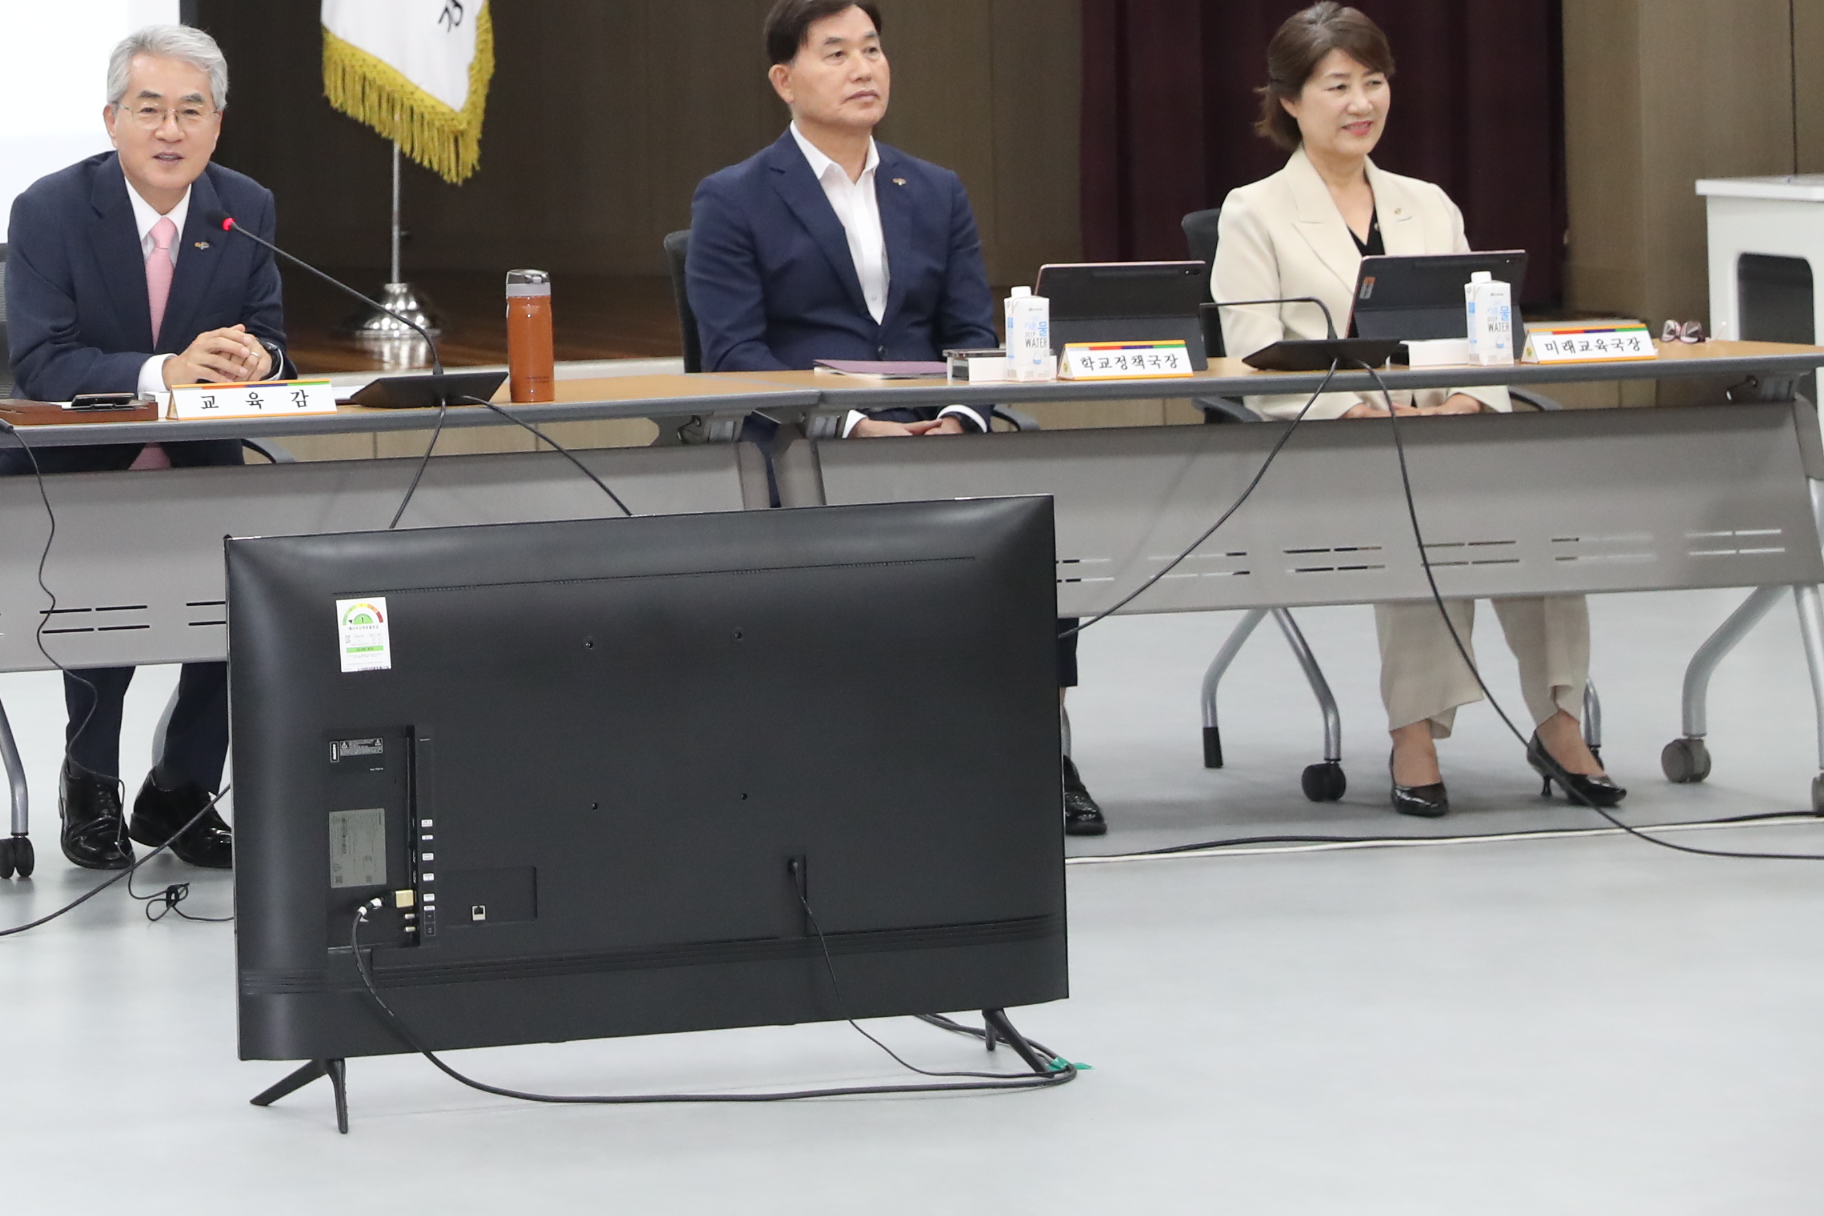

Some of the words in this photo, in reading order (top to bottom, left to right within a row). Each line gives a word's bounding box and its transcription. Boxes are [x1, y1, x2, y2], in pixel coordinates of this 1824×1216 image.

[1487, 321, 1510, 333] WATER
[1024, 337, 1048, 348] WATER
[1545, 337, 1642, 356] 미래교육국장
[1079, 353, 1179, 372] 학교정책국장
[199, 388, 310, 411] 교육감
